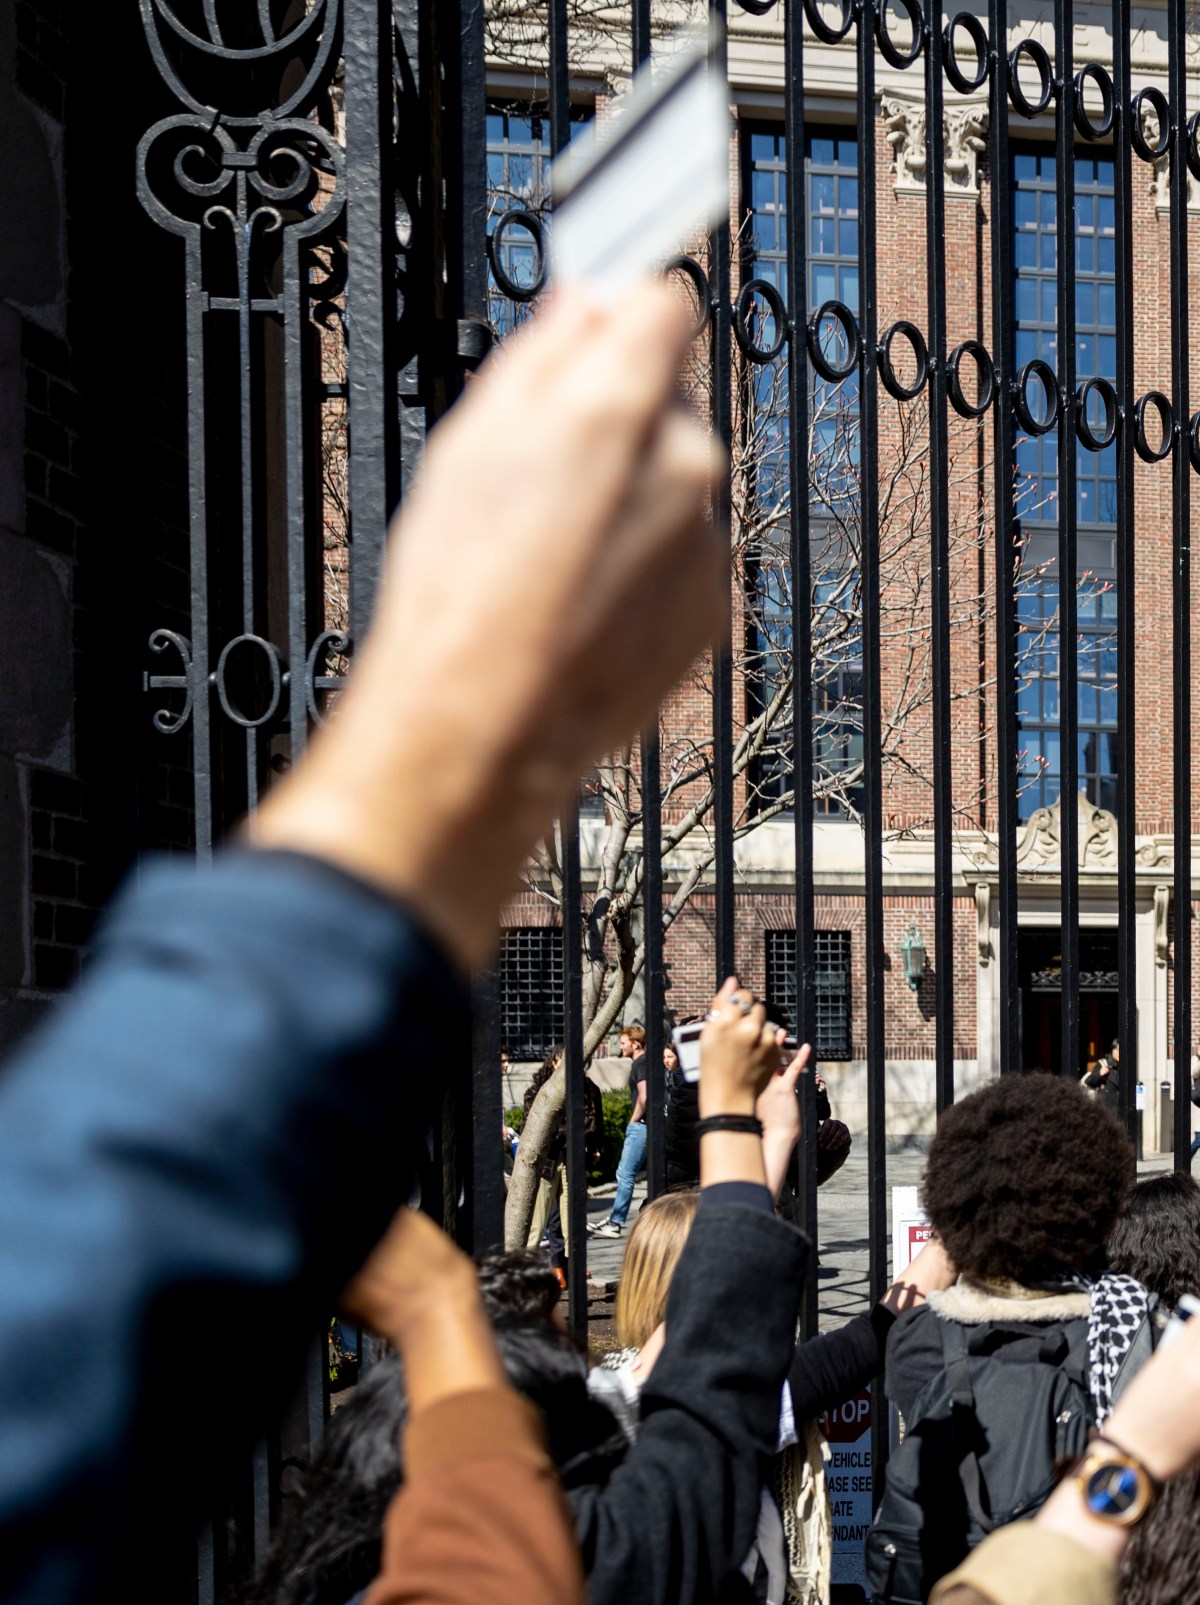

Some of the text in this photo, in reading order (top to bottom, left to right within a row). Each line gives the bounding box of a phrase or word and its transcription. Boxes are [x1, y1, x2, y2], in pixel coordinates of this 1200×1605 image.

[827, 1452, 873, 1468] VEHICLE
[826, 1476, 872, 1492] ASE SEE
[832, 1525, 870, 1542] NDANT
